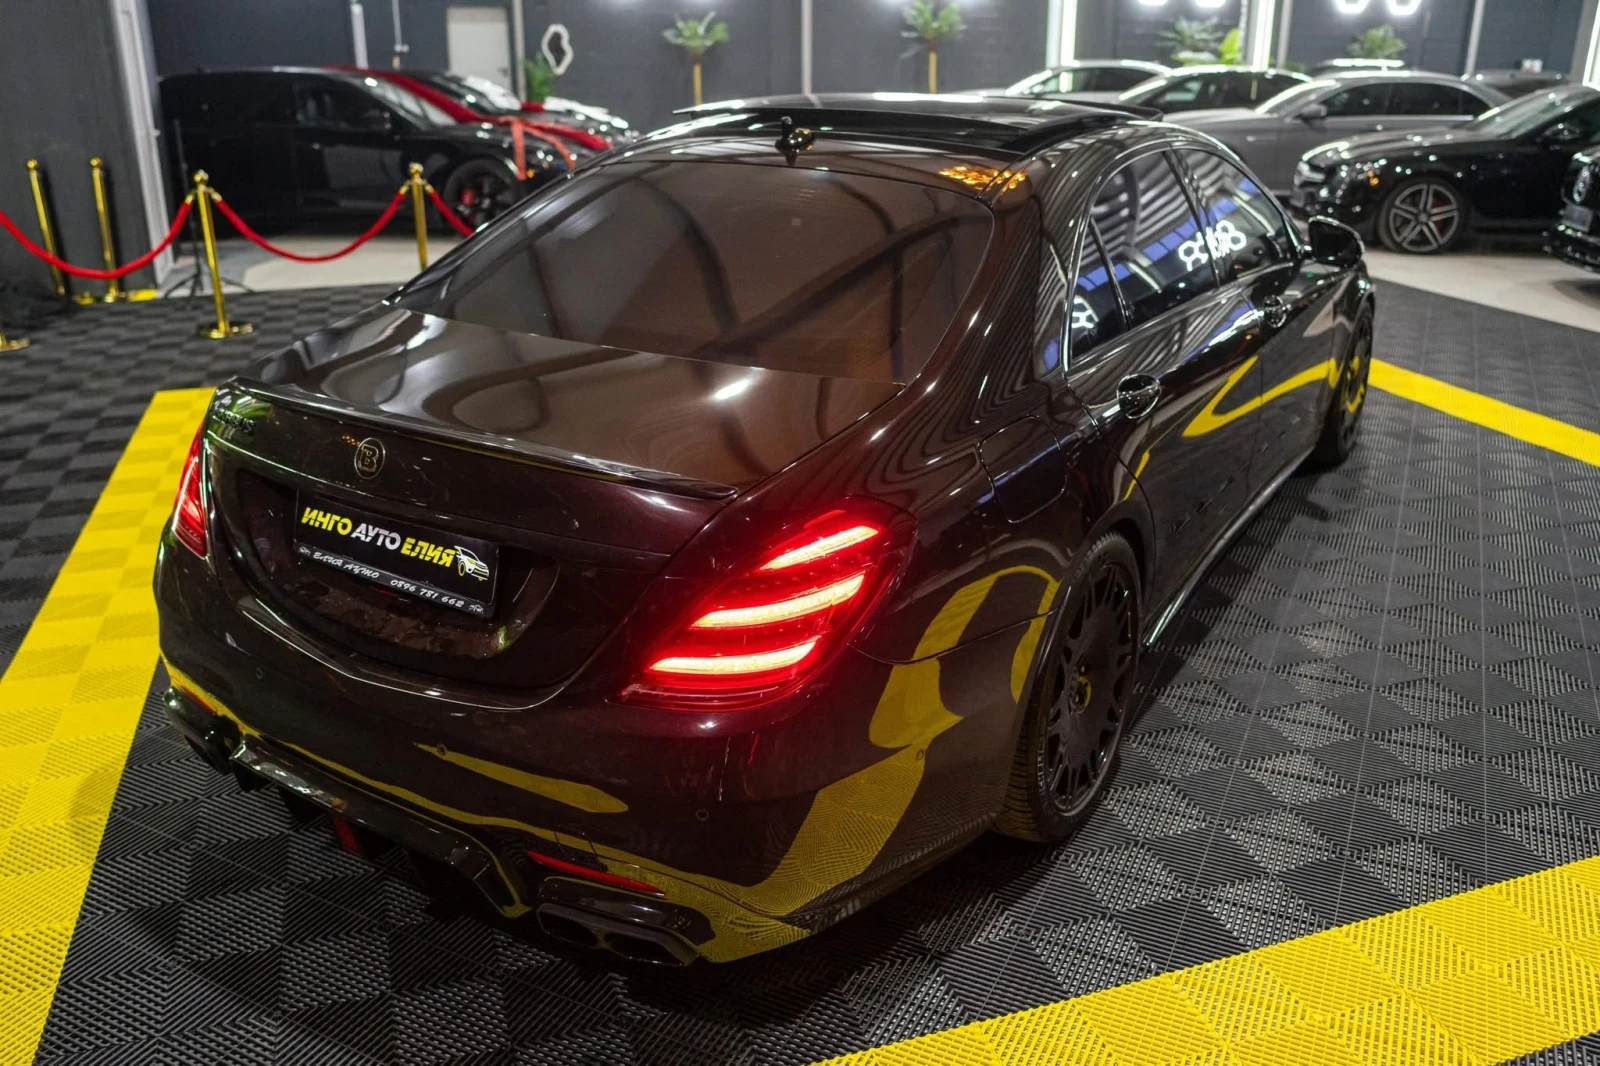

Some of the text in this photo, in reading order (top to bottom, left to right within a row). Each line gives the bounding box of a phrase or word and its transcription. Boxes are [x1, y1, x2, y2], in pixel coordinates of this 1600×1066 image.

[358, 444, 379, 472] B
[301, 507, 456, 567] ИНГО АУТО ЕЛИЯ
[390, 580, 417, 592] 0896
[420, 588, 438, 599] 781
